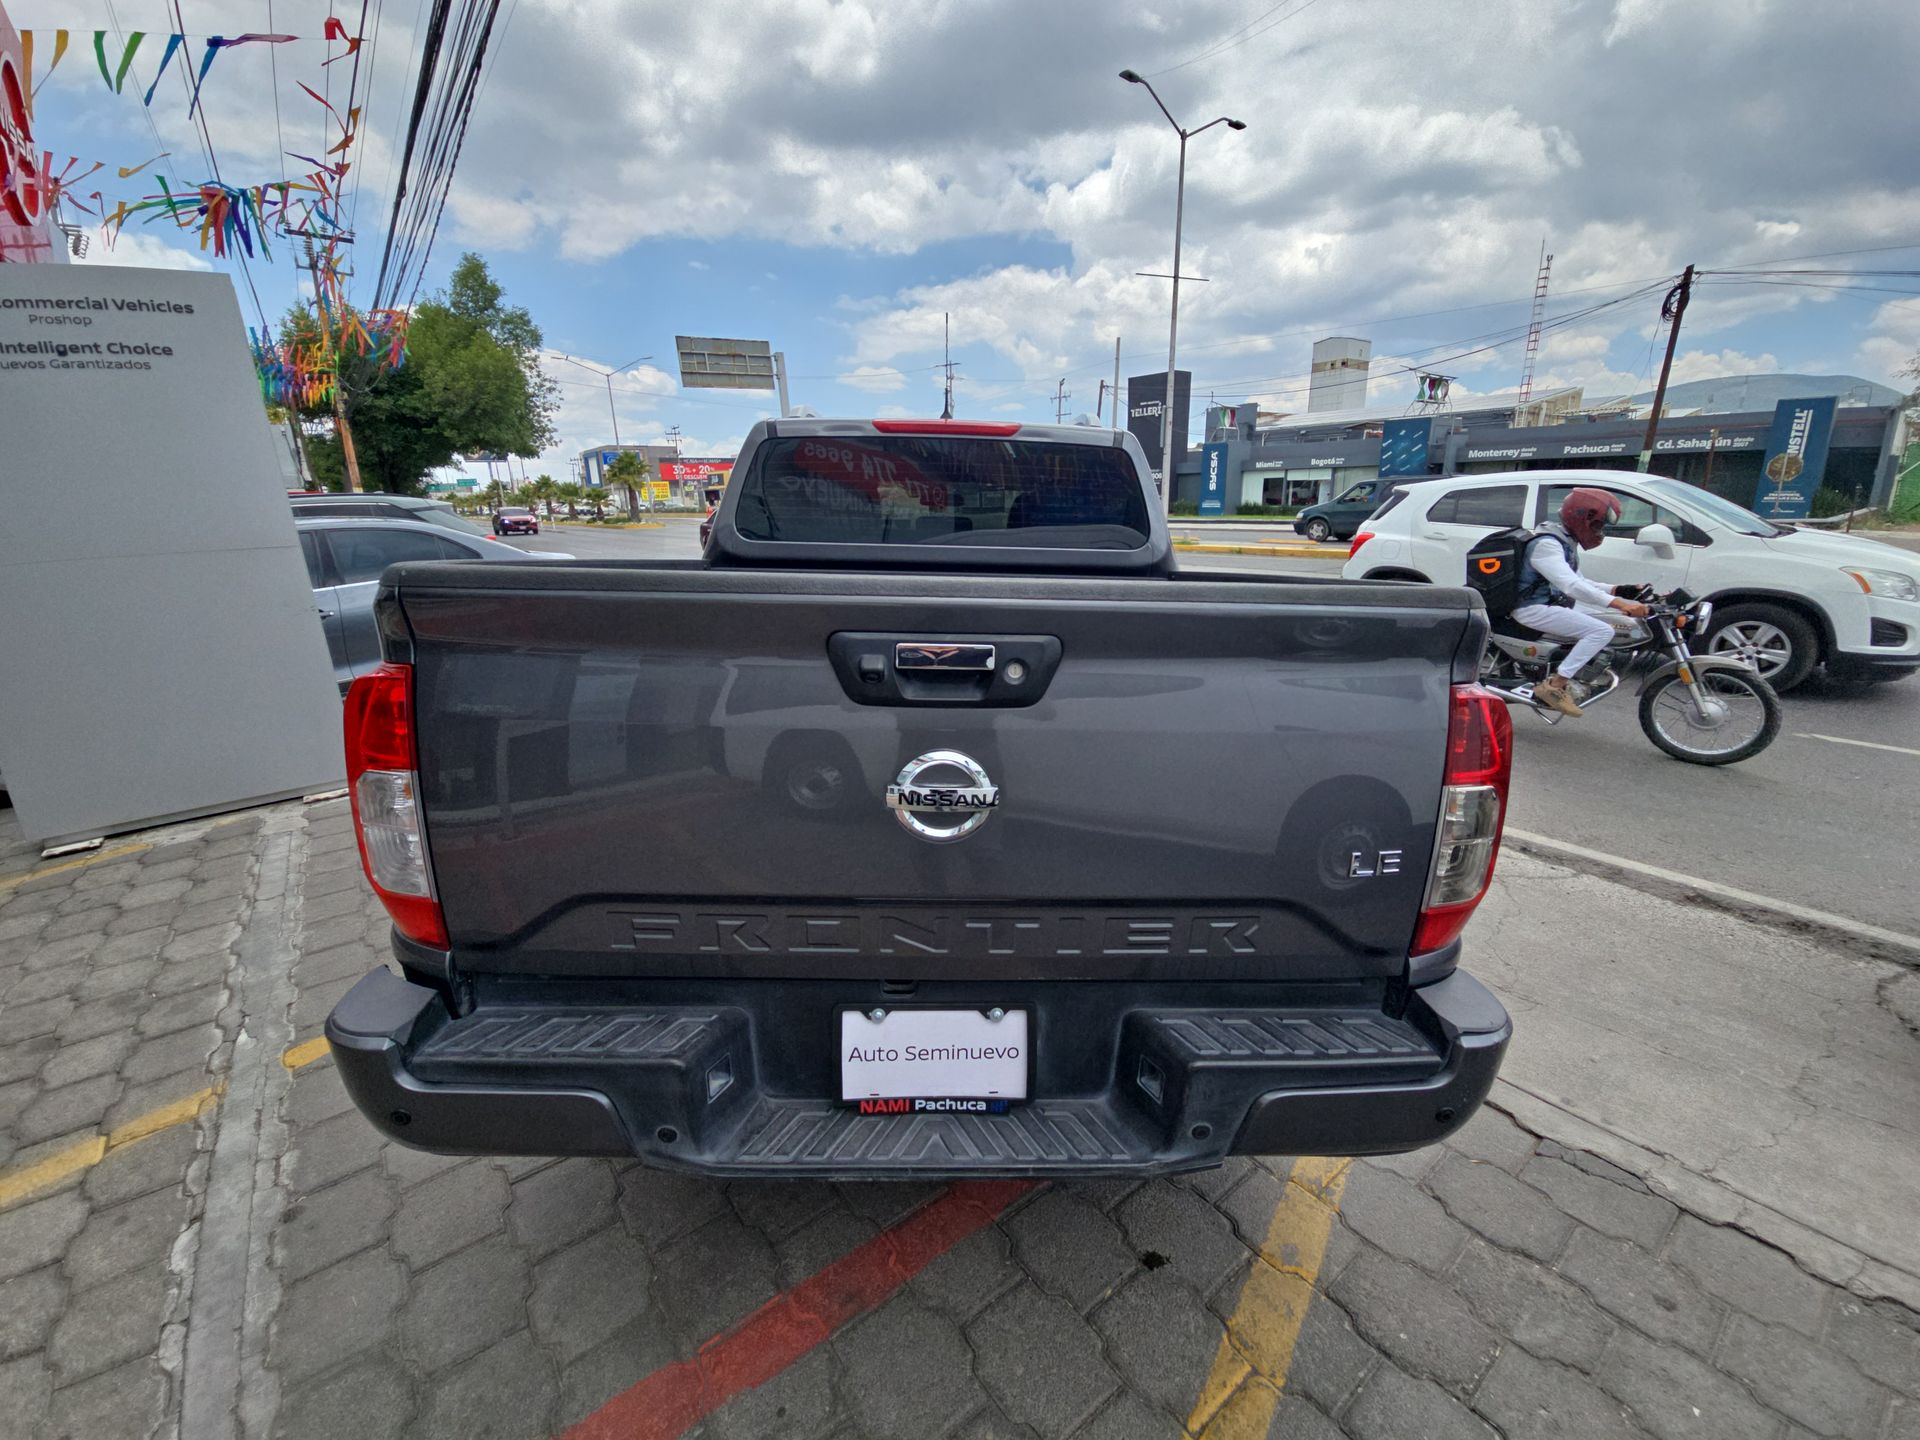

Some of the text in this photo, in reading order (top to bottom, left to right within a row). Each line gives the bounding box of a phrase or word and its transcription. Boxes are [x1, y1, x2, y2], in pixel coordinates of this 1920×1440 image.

[0, 297, 195, 314] ommercial Vehicles
[28, 314, 93, 327] Proshop
[0, 341, 174, 356] Intelligent Choice
[0, 358, 152, 370] uevos Garantizados
[1563, 444, 1610, 454] Pachuca
[1656, 439, 1675, 449] Cd.
[1468, 447, 1520, 458] Monterrey
[1311, 457, 1335, 466] Bogotá
[1209, 450, 1219, 491] SYCSA
[897, 791, 988, 809] NISSAN
[1349, 849, 1403, 877] LE
[606, 911, 1260, 953] FRONTIER
[848, 1044, 1019, 1062] Auto Seminuevo
[860, 1098, 987, 1114] NAMI Pachuca
